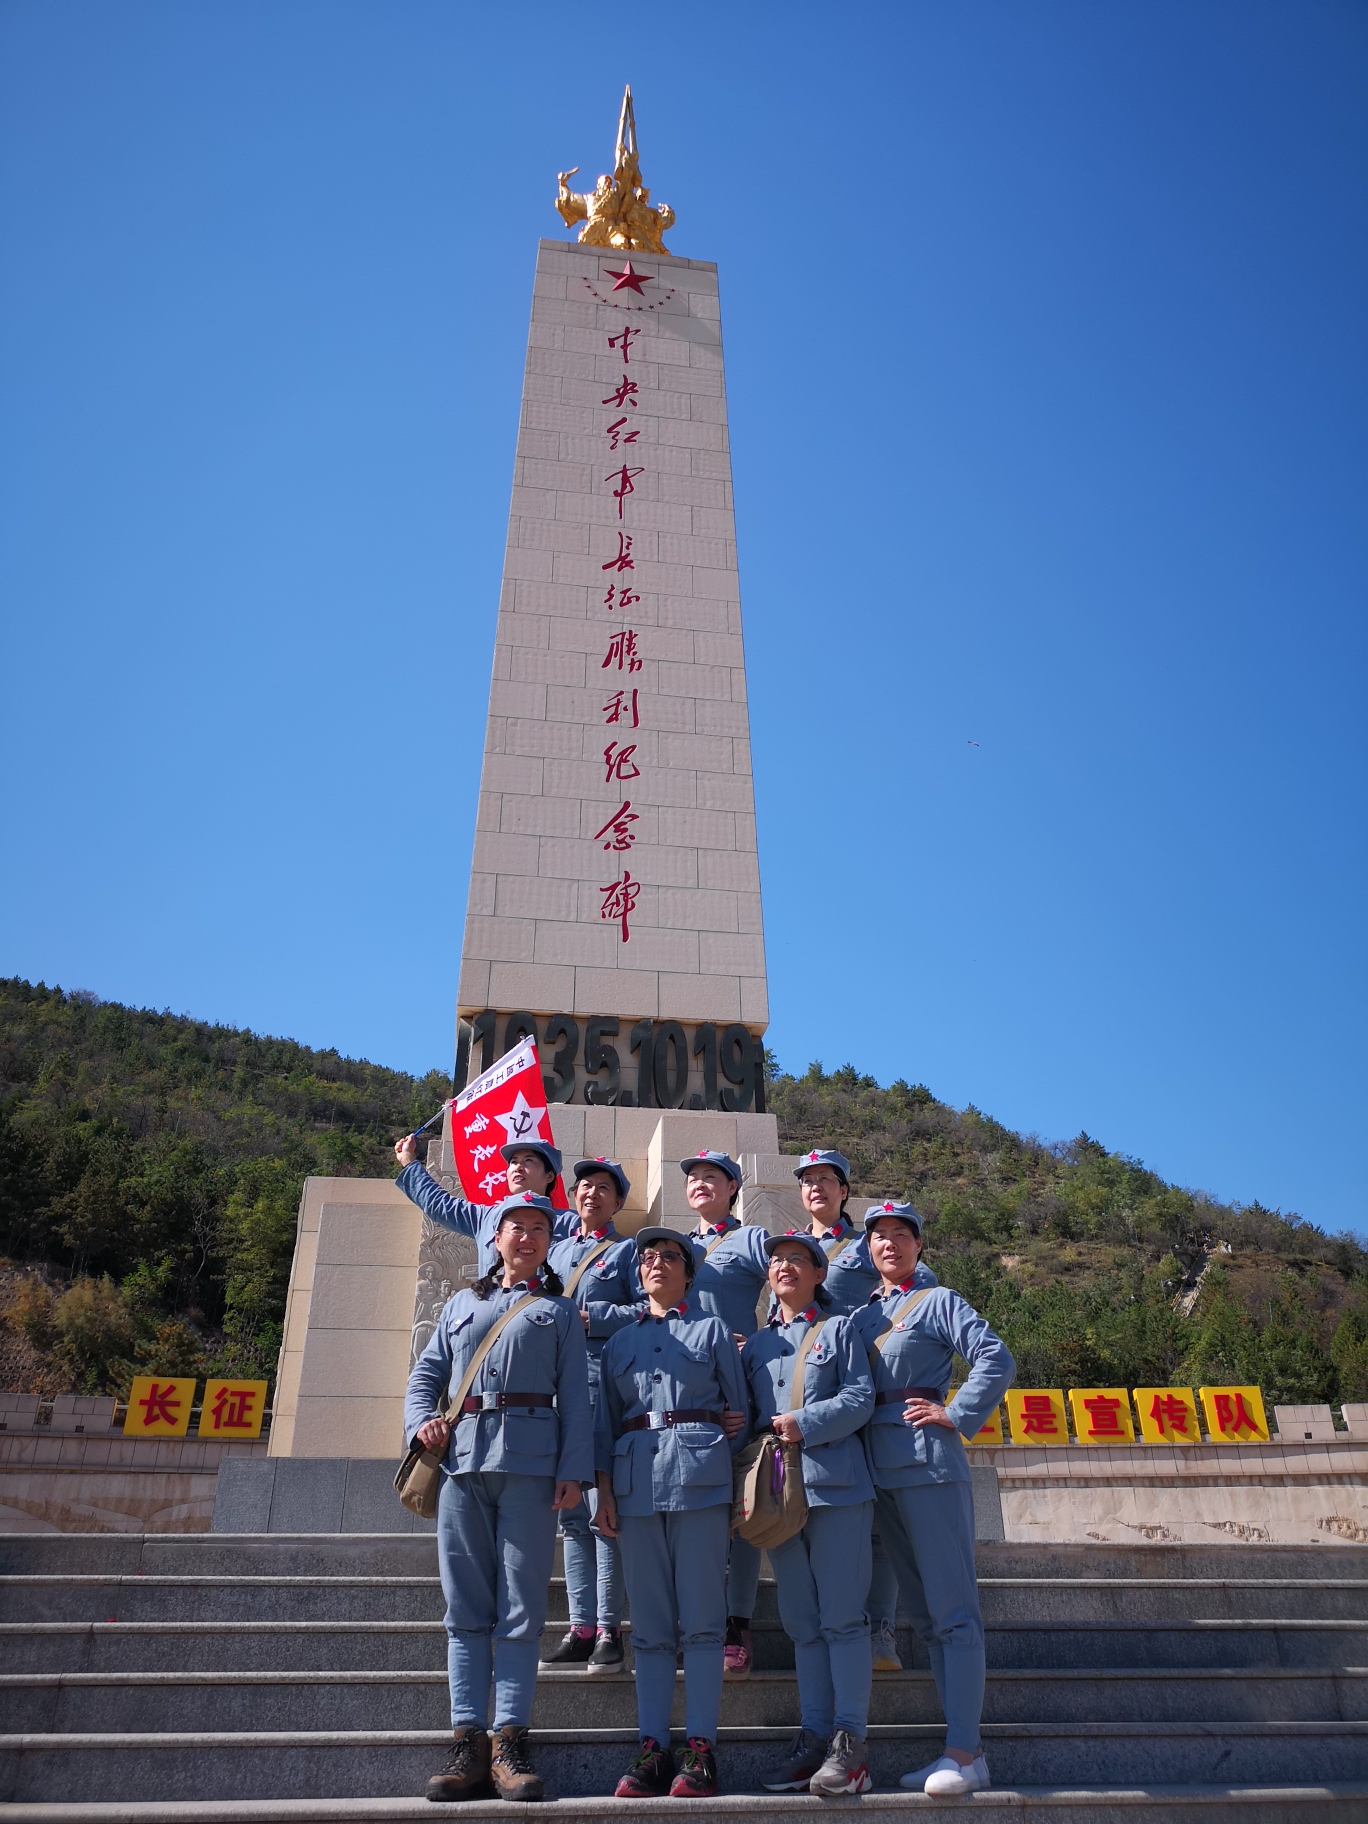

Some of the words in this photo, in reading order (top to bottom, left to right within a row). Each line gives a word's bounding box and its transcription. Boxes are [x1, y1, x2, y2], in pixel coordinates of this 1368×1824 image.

[463, 1112, 507, 1204] 重走长
[138, 1383, 256, 1430] 长征
[978, 1392, 1259, 1436] 是宣传队
